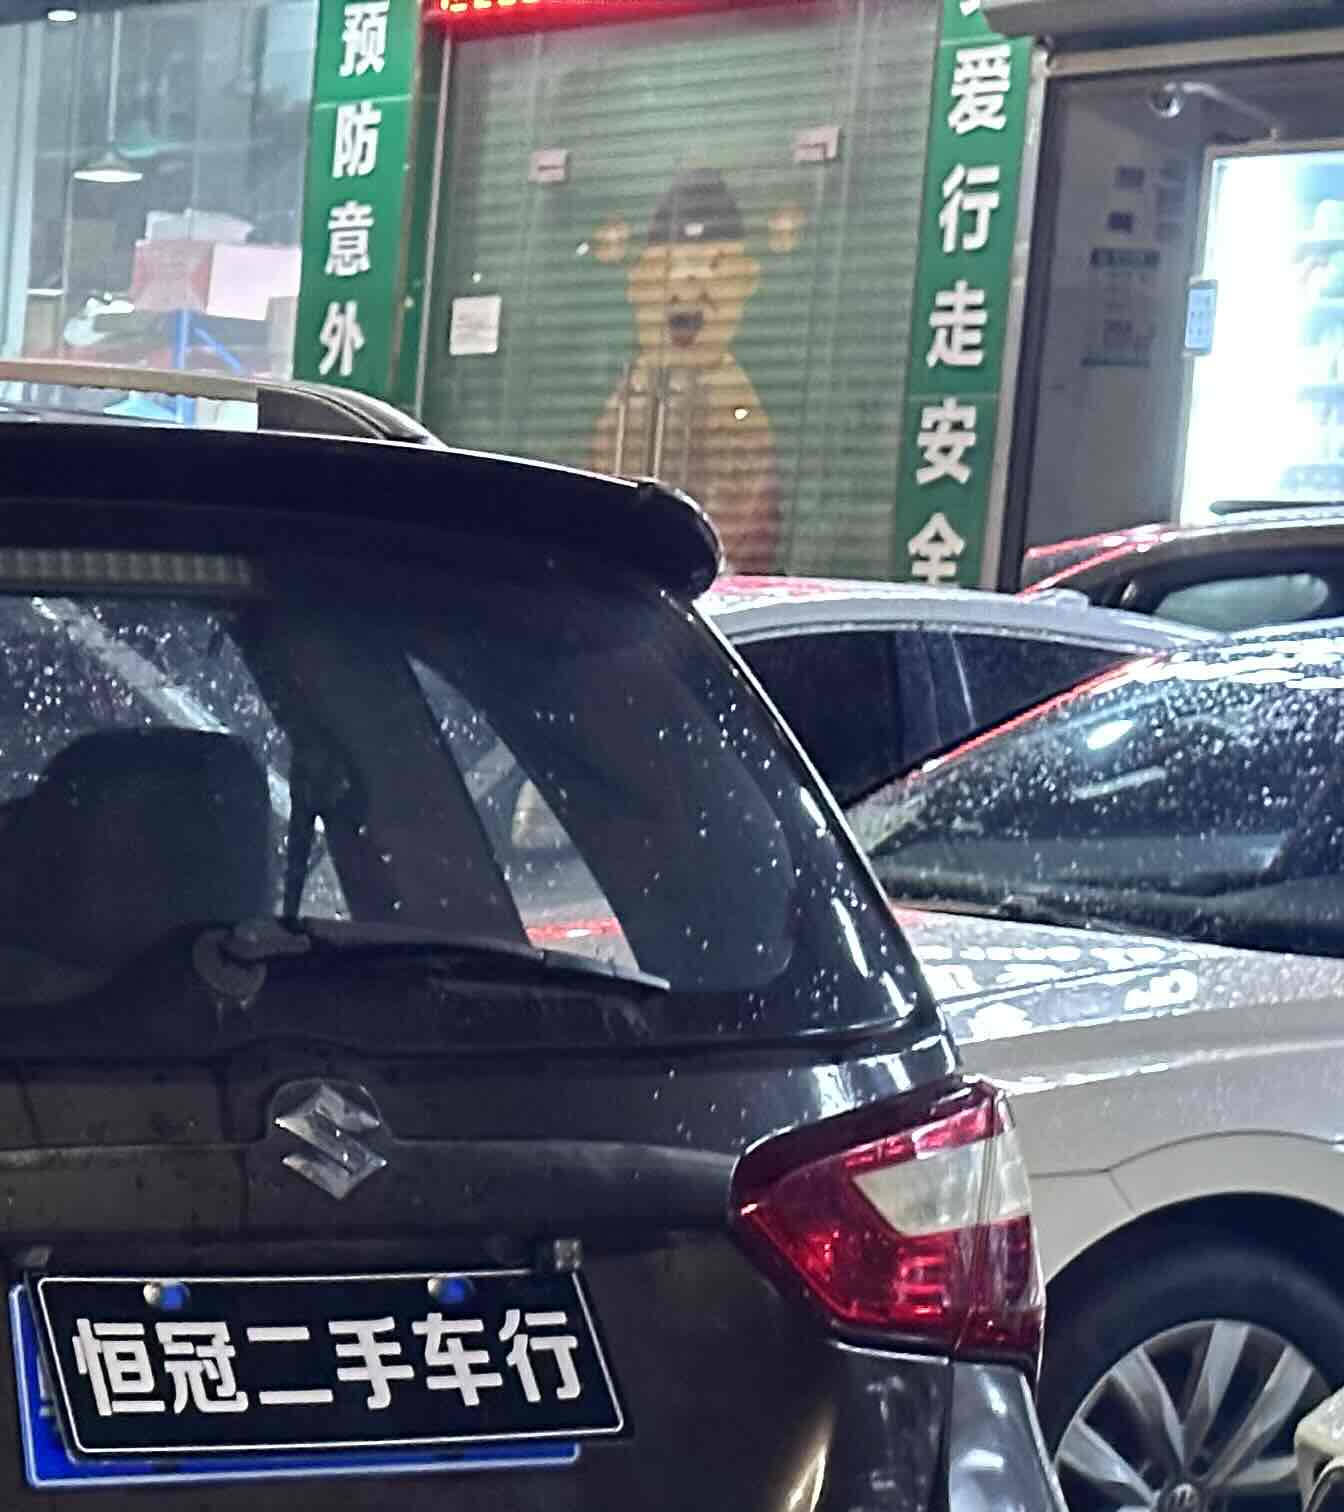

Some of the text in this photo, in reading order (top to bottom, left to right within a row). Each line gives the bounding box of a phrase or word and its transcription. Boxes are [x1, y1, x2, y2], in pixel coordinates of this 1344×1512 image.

[317, 0, 391, 377] 预防意外
[907, 0, 1011, 589] 爱行走安全
[72, 1309, 581, 1416] 恒冠二手车行
